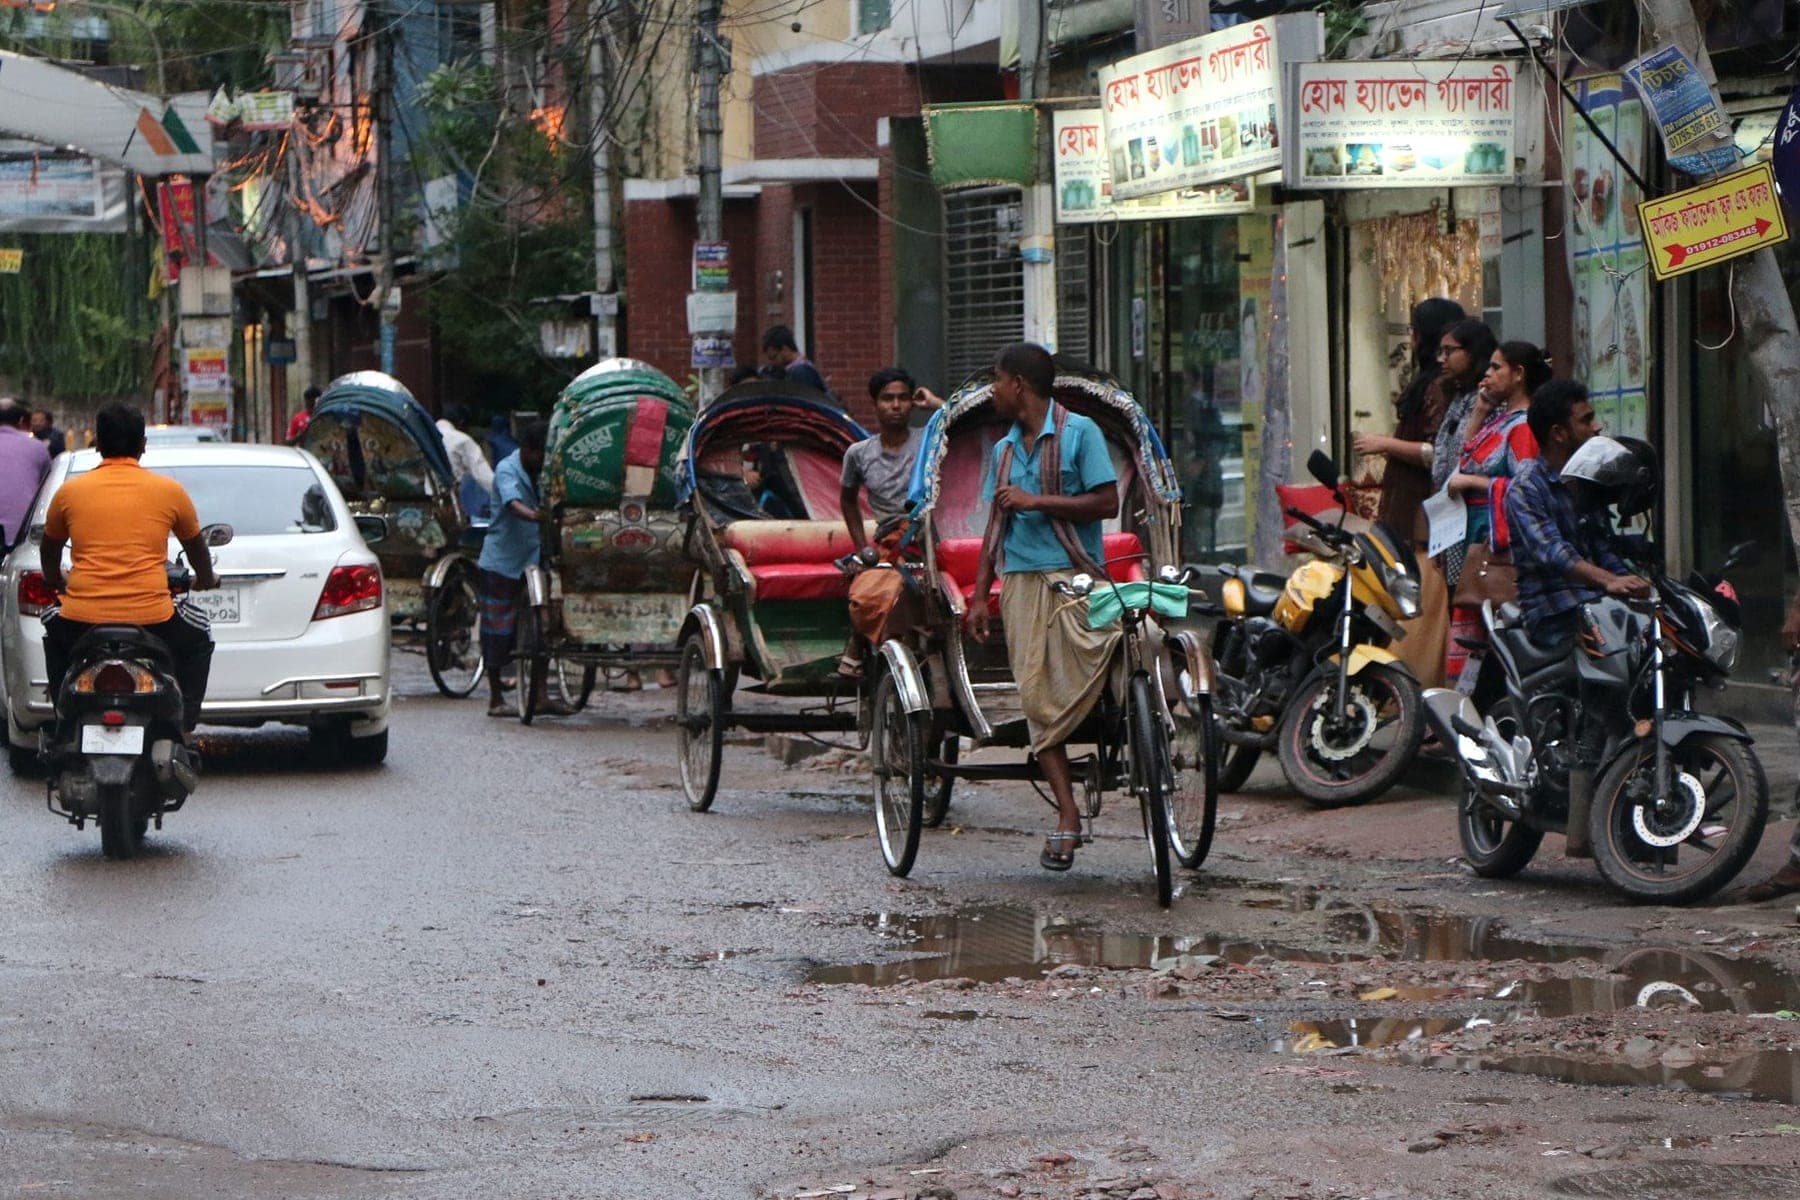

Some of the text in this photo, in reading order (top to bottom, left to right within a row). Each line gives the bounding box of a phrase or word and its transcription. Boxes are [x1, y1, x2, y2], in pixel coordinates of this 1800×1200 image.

[1106, 74, 1139, 112] হোম
[1144, 56, 1203, 100] হ্যাভেন
[1208, 24, 1272, 83] গ্যালারী
[1301, 78, 1348, 114] হোম
[1354, 77, 1428, 114] হ্যাভেন
[1437, 64, 1513, 113] গ্যালারী
[1058, 125, 1099, 157] হোম
